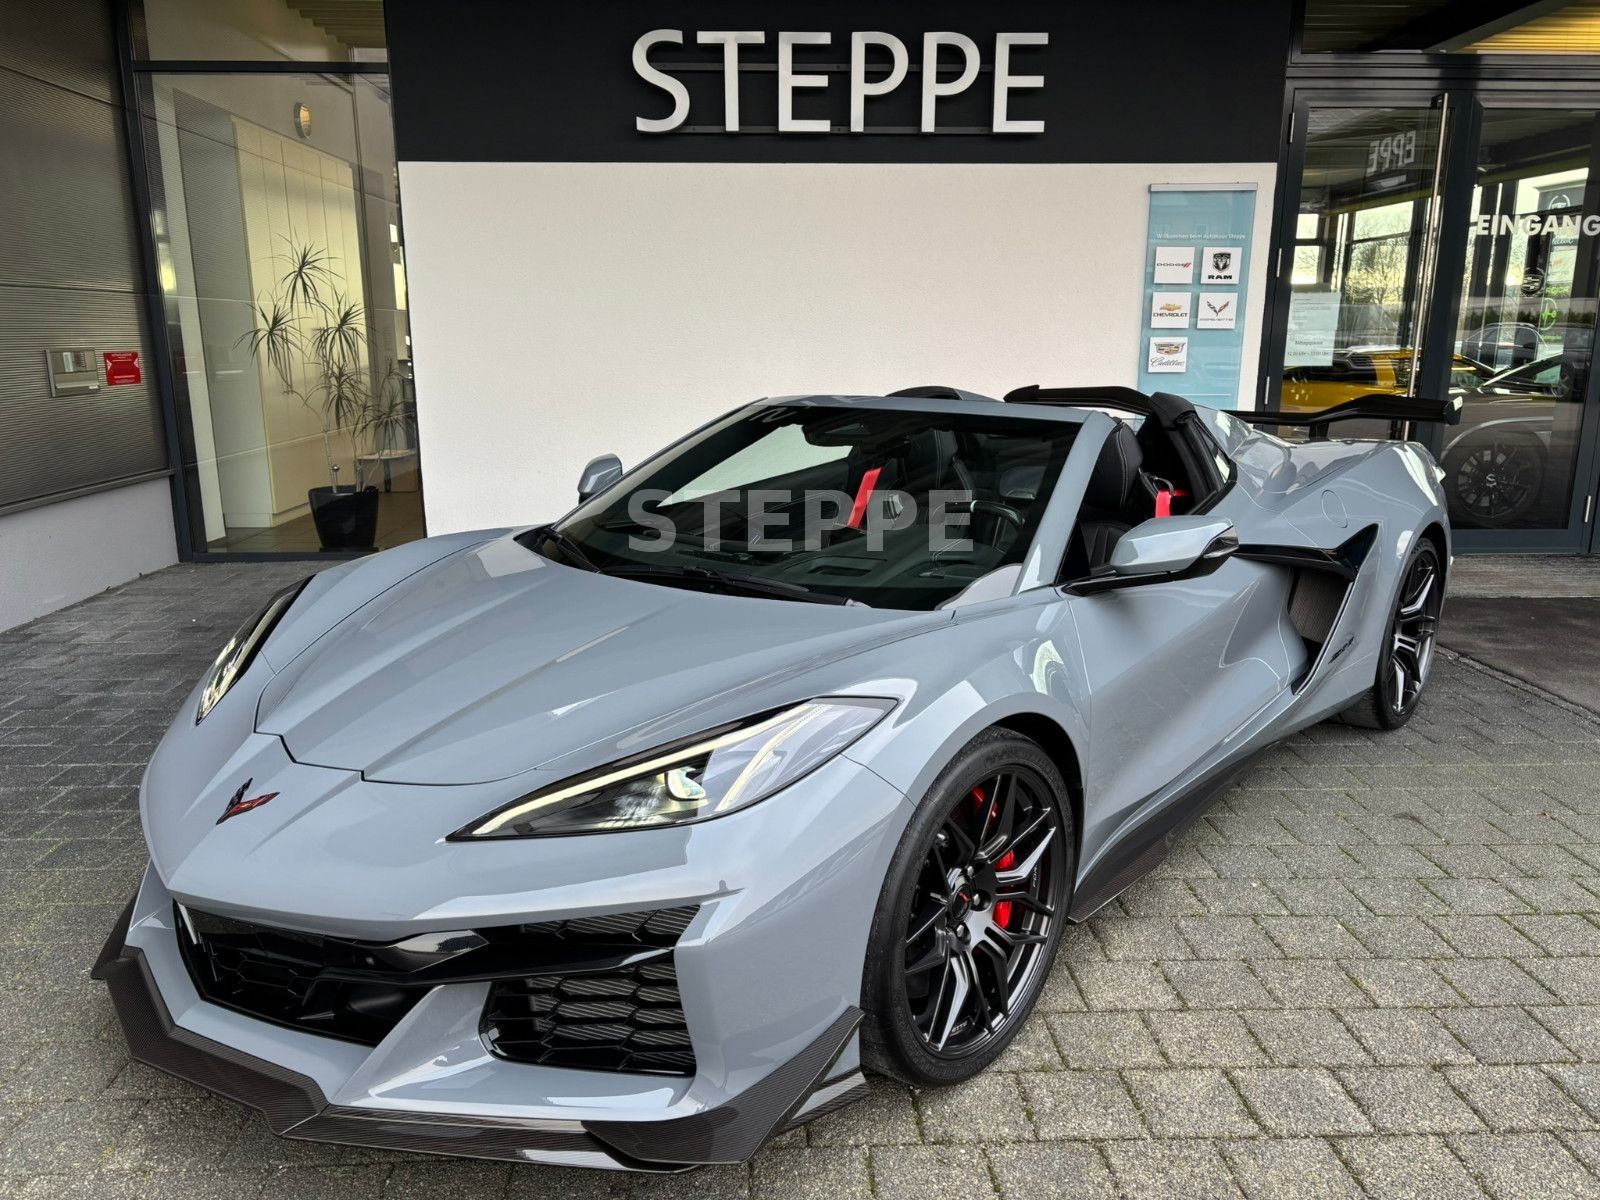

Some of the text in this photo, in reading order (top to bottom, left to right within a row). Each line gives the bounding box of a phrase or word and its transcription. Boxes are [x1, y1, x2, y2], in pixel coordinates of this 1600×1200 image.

[632, 29, 1049, 133] STEPPE
[1477, 214, 1600, 236] EINGANG
[1150, 357, 1185, 367] Cadillac
